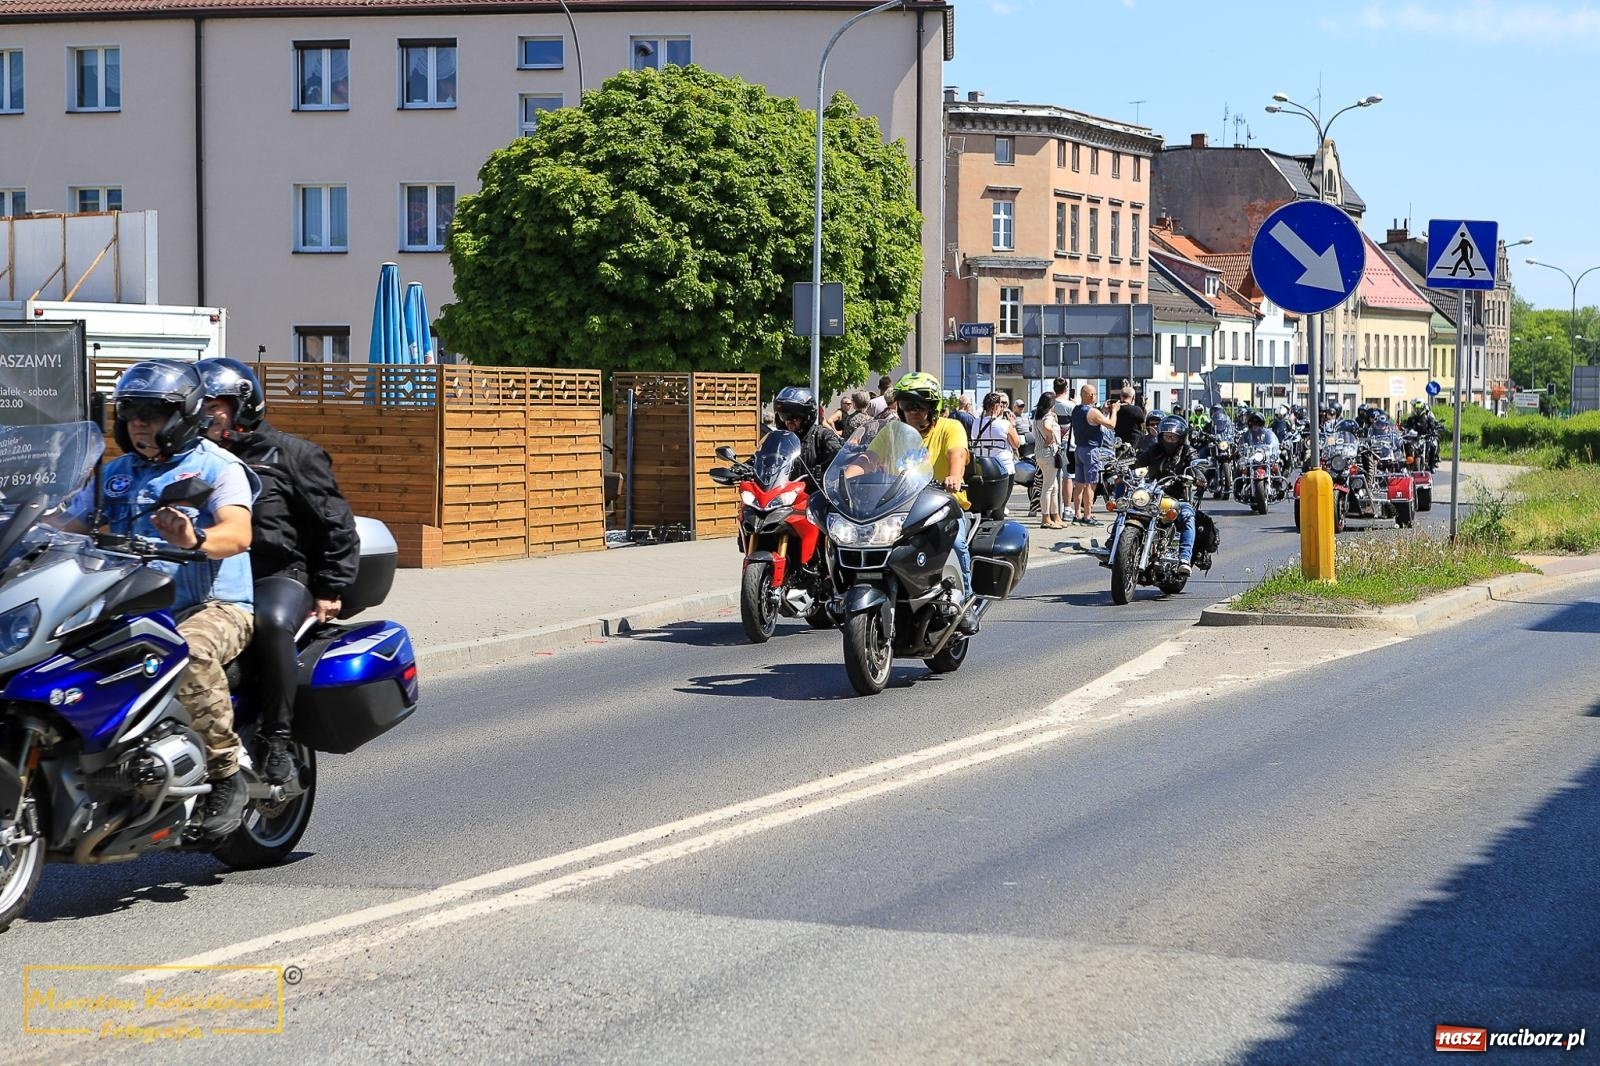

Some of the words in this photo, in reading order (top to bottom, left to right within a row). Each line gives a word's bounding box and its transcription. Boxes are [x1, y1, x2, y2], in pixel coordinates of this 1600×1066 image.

[0, 353, 62, 368] ASZAMY!
[28, 386, 58, 397] sobota
[0, 398, 24, 409] 23.00
[12, 473, 32, 486] 891
[34, 471, 57, 487] 962
